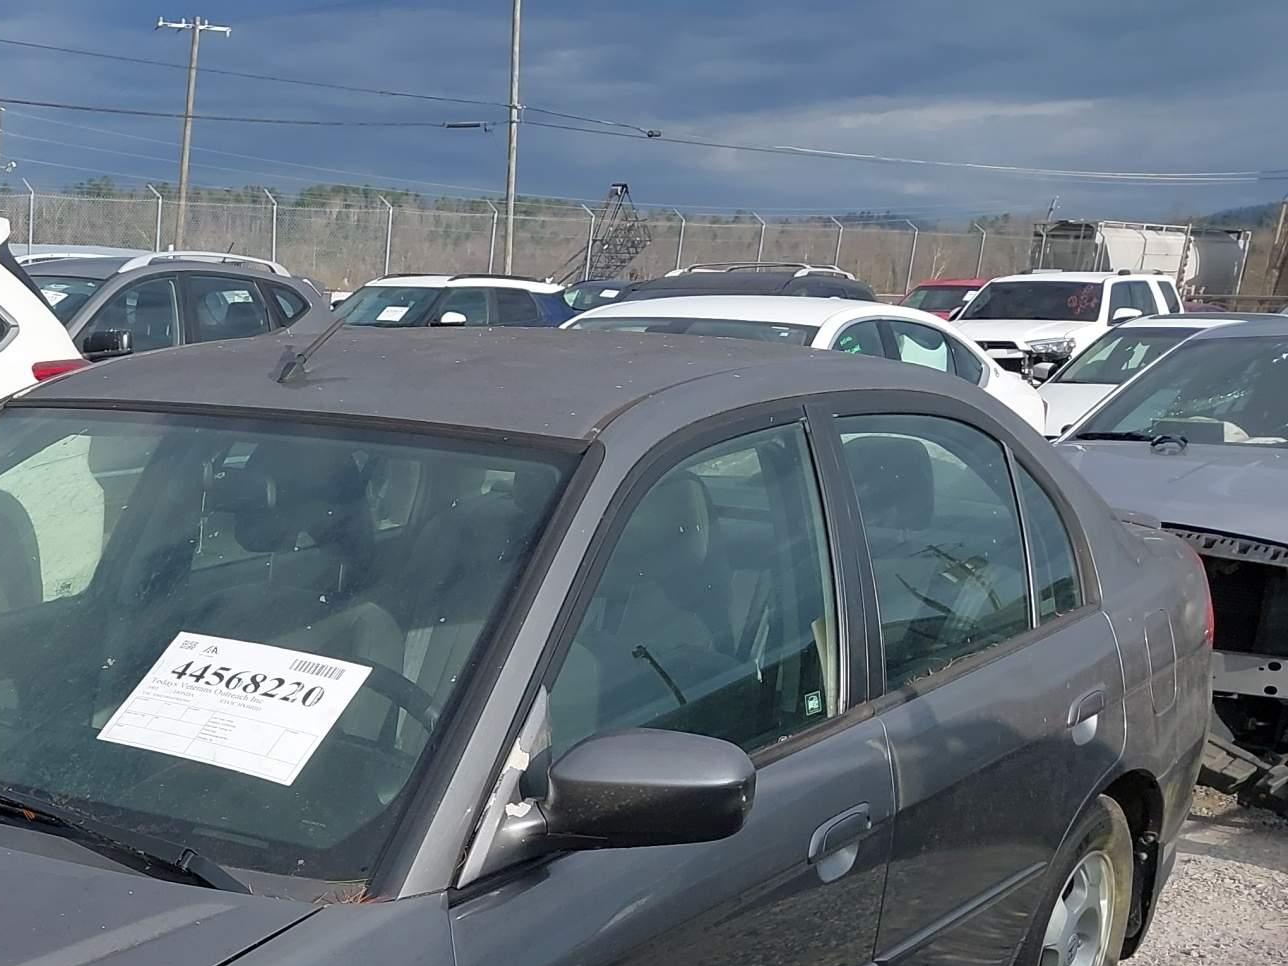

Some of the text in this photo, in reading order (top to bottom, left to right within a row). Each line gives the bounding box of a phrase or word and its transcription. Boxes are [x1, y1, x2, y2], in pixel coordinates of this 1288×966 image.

[171, 660, 325, 708] 44568220
[180, 681, 213, 694] Veterans
[214, 687, 249, 702] Outreach
